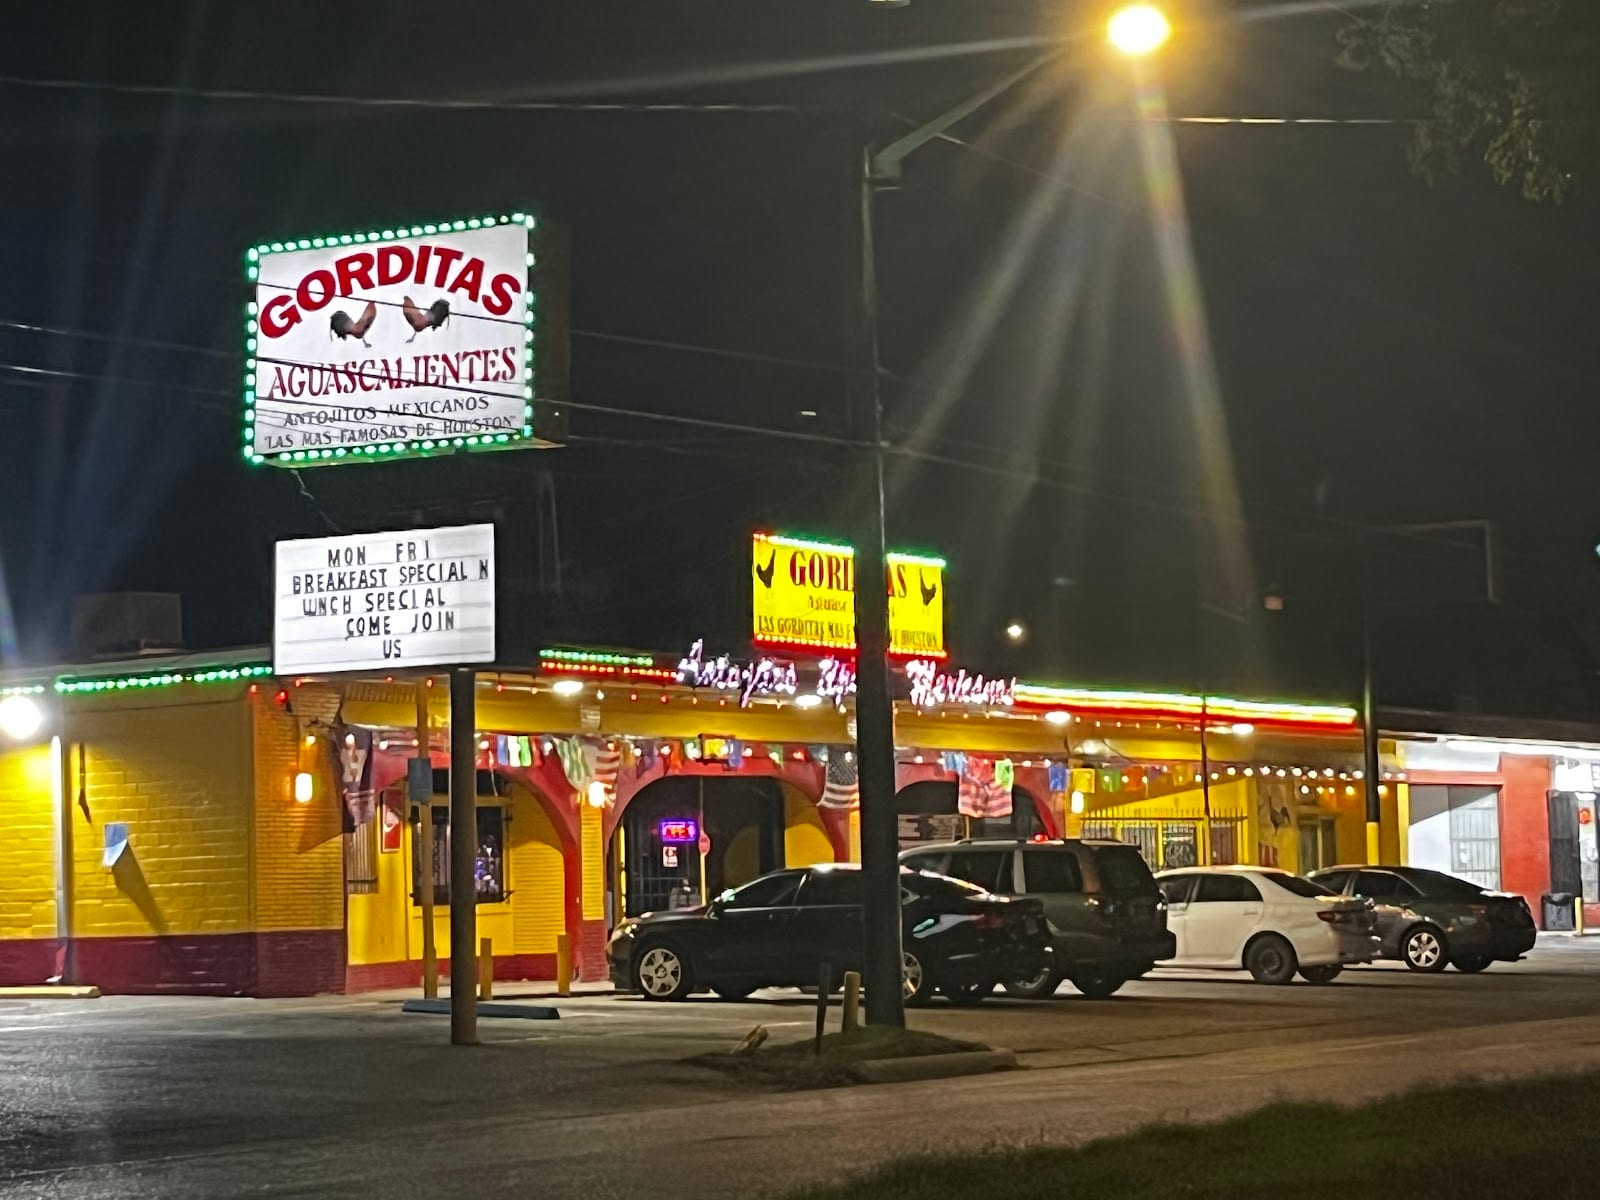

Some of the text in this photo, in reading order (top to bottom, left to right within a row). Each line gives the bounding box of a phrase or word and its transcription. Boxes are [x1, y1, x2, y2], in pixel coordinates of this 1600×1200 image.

[259, 245, 521, 338] GORDITAS
[269, 347, 516, 400] AGUASCALIENTES
[302, 431, 332, 447] MAS
[340, 425, 408, 443] FAMOSAS
[416, 422, 435, 437] DE
[328, 540, 430, 568] MON FRI
[292, 568, 388, 595] BREAKFAST
[399, 560, 468, 586] SPECIAL
[365, 587, 446, 613] SPECIAL
[345, 611, 455, 641] COME JOIN
[382, 639, 402, 659] US
